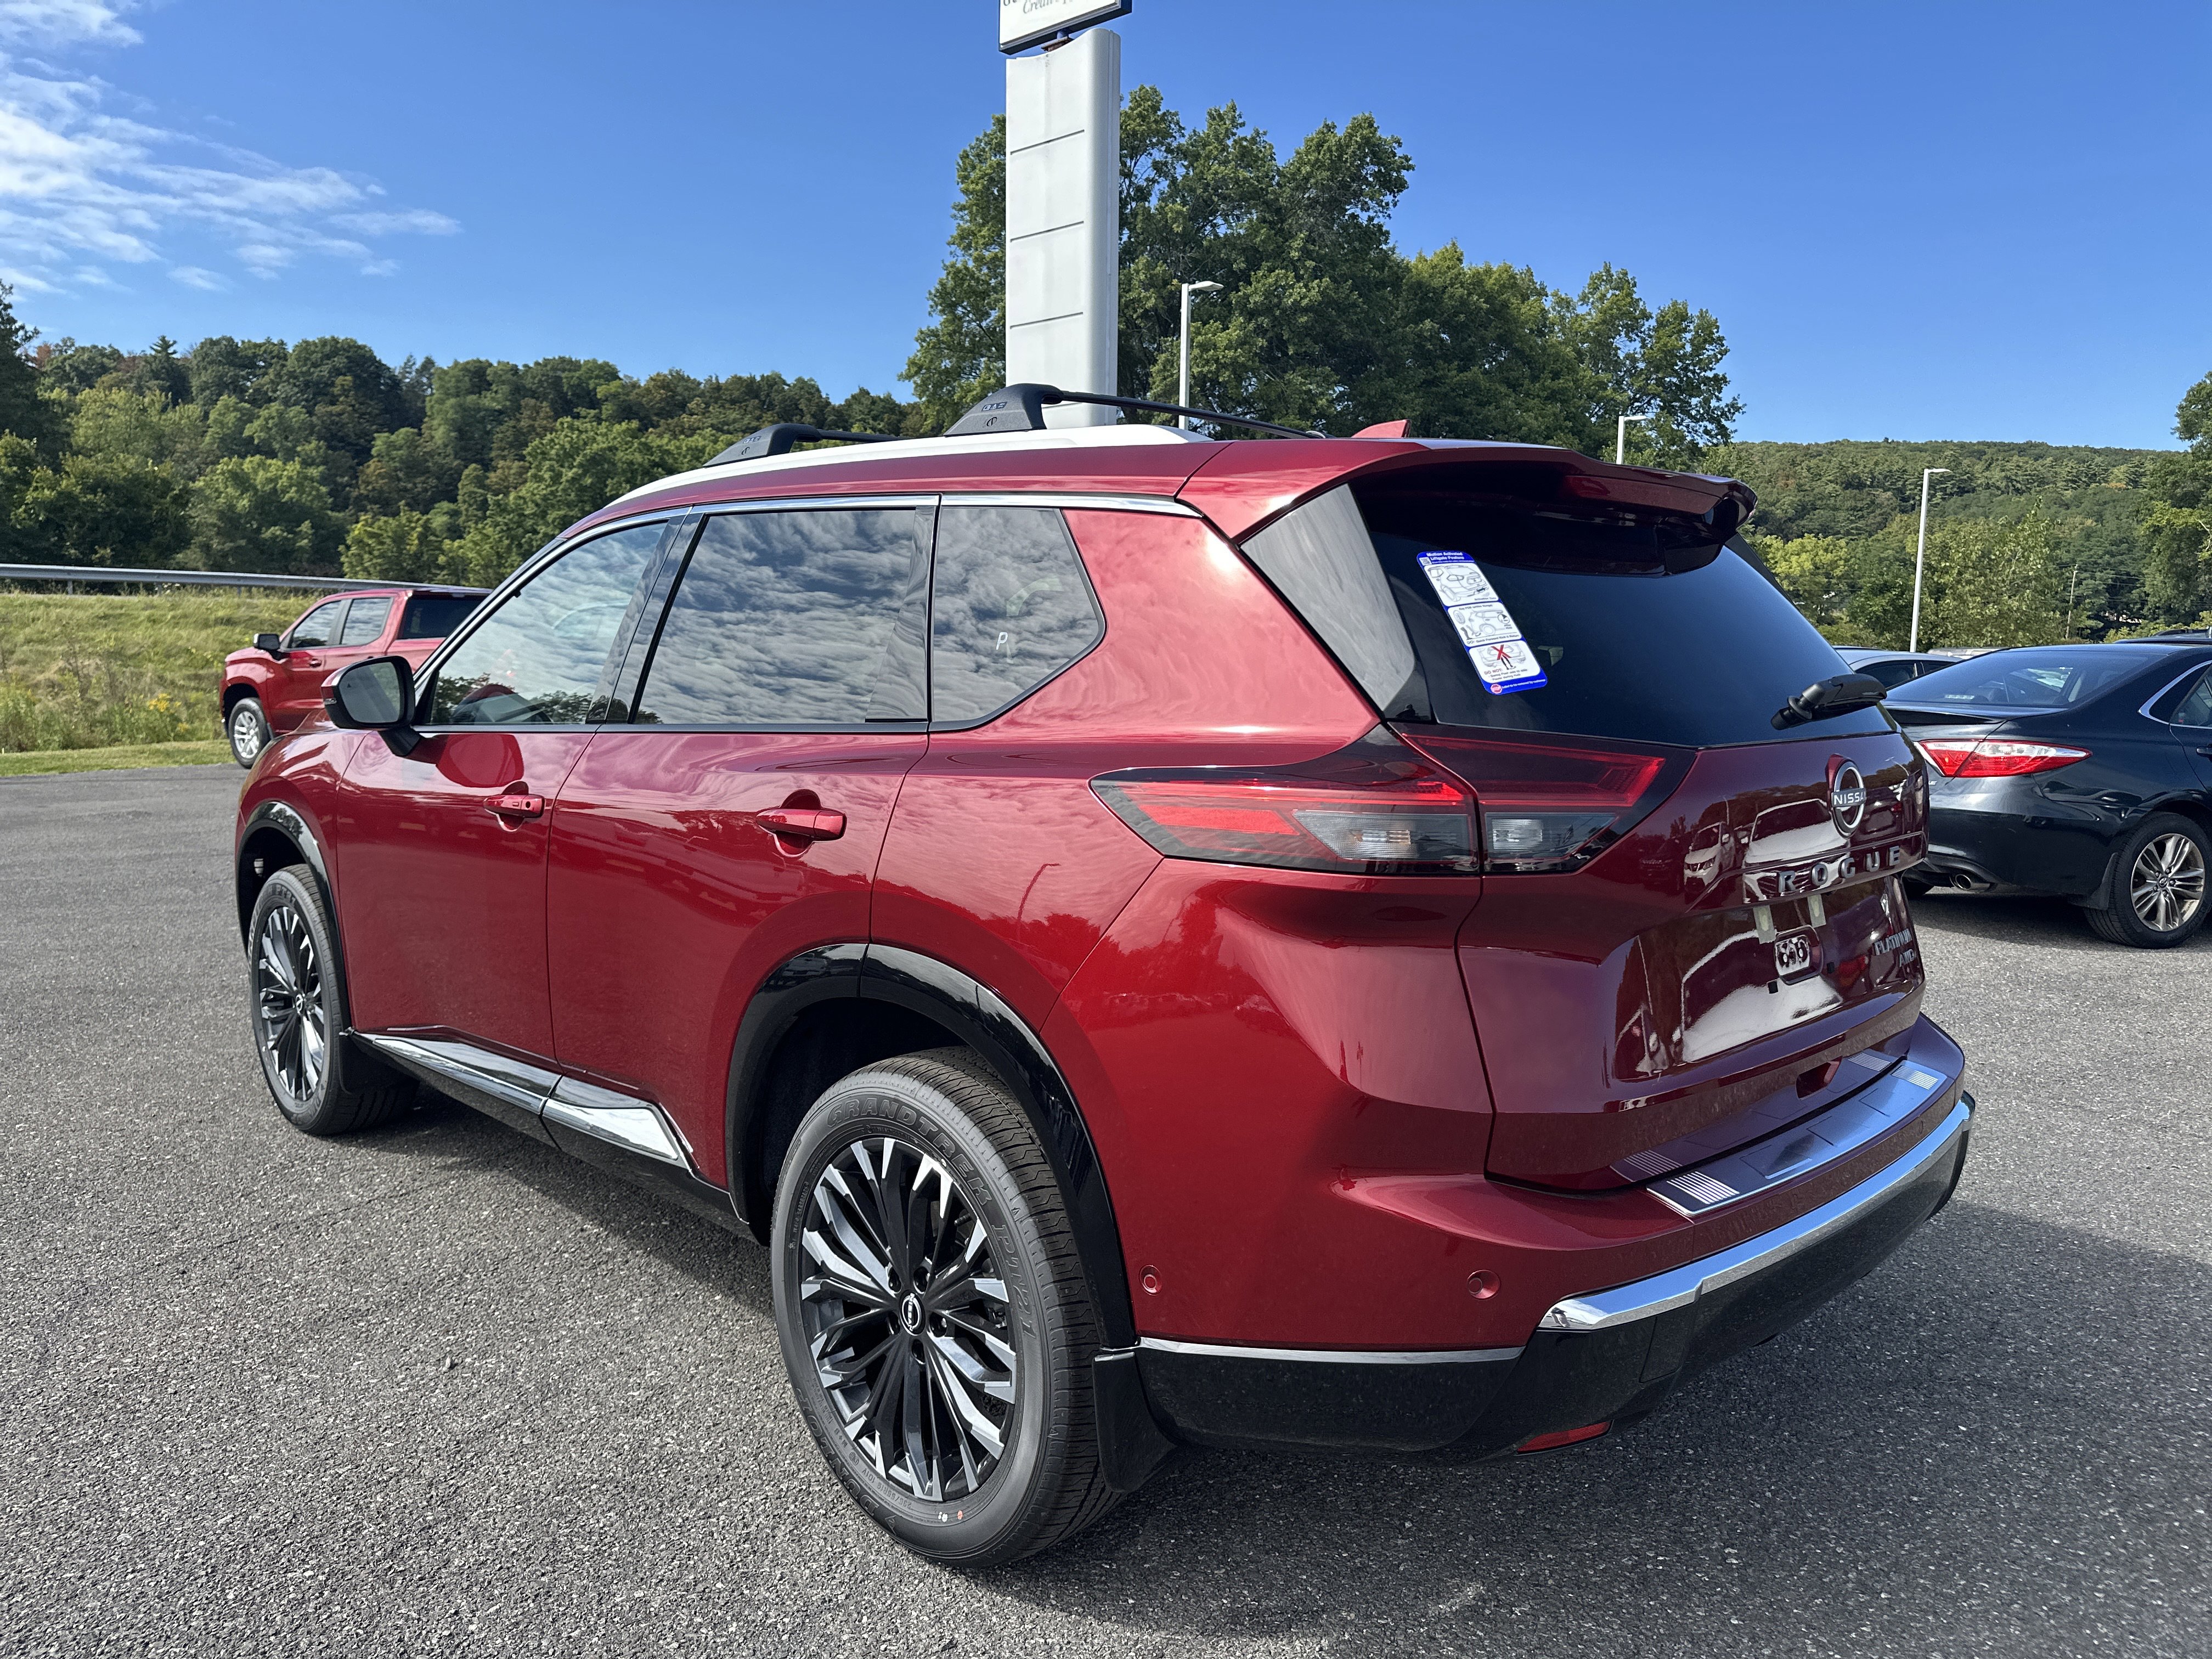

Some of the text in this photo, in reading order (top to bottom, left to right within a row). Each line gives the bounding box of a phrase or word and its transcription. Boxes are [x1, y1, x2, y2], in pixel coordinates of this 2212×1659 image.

[996, 631, 1008, 650] P
[1778, 845, 1901, 894] ROGUE
[827, 1097, 992, 1206] GRANDTREK
[796, 1387, 880, 1517] DUNLOP
